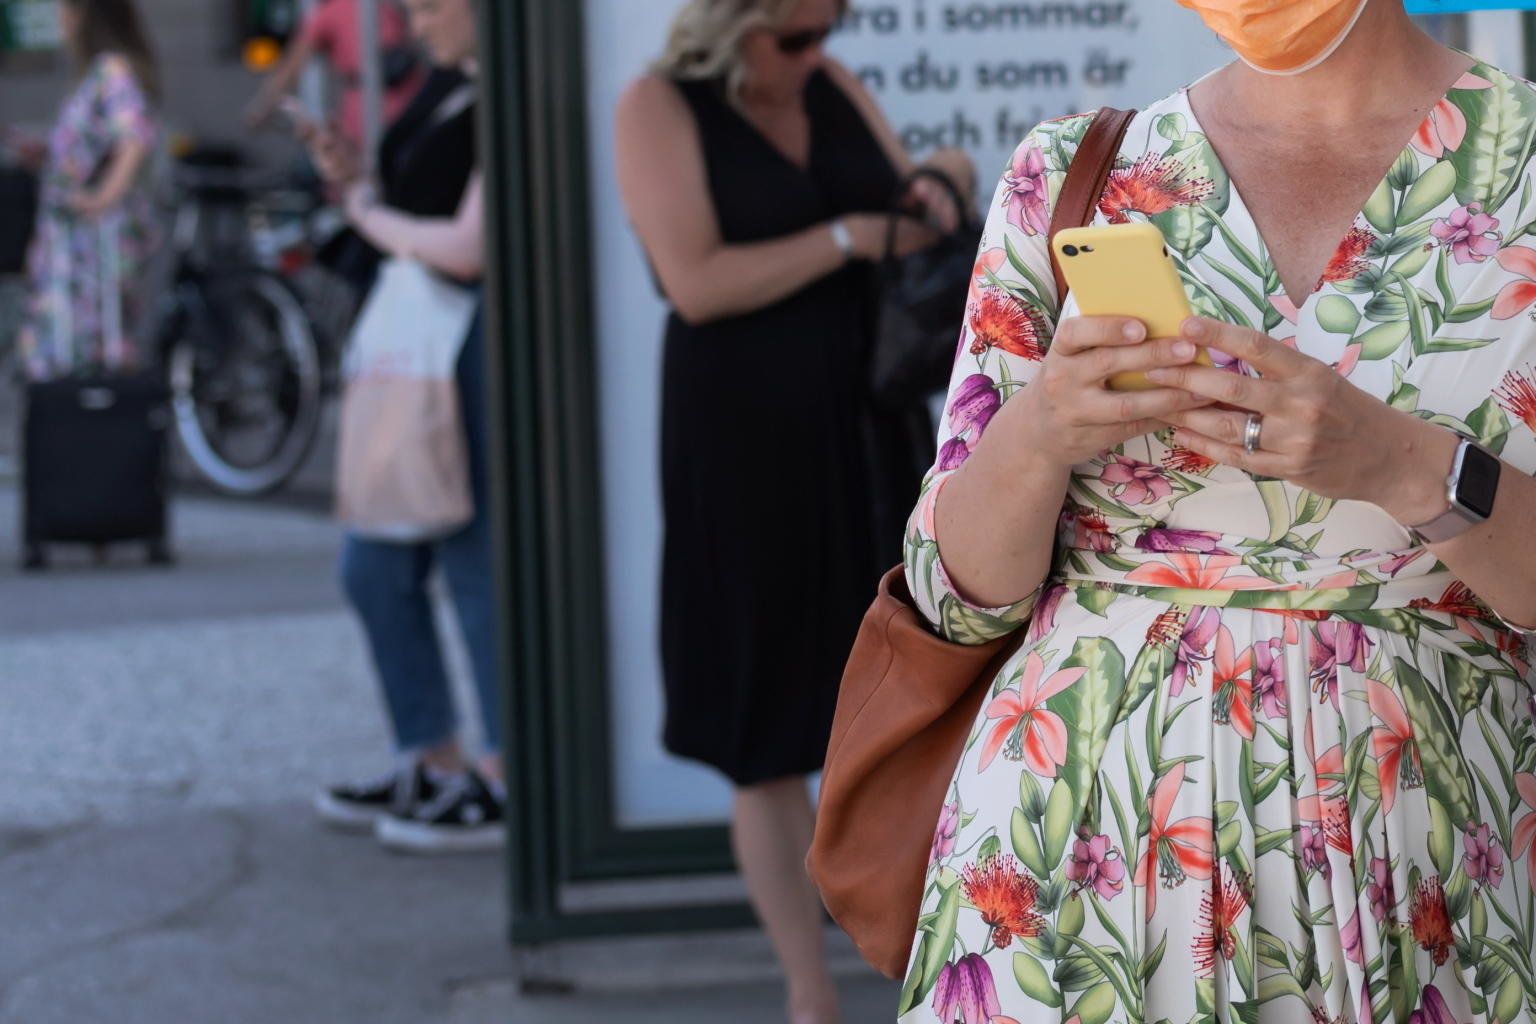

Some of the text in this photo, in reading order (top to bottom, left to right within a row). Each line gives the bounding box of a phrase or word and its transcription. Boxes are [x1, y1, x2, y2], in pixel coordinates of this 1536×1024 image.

[943, 0, 1139, 34] sommar,
[899, 51, 960, 92] du
[974, 61, 1069, 91] som
[1082, 50, 1131, 88] är
[902, 111, 982, 151] och
